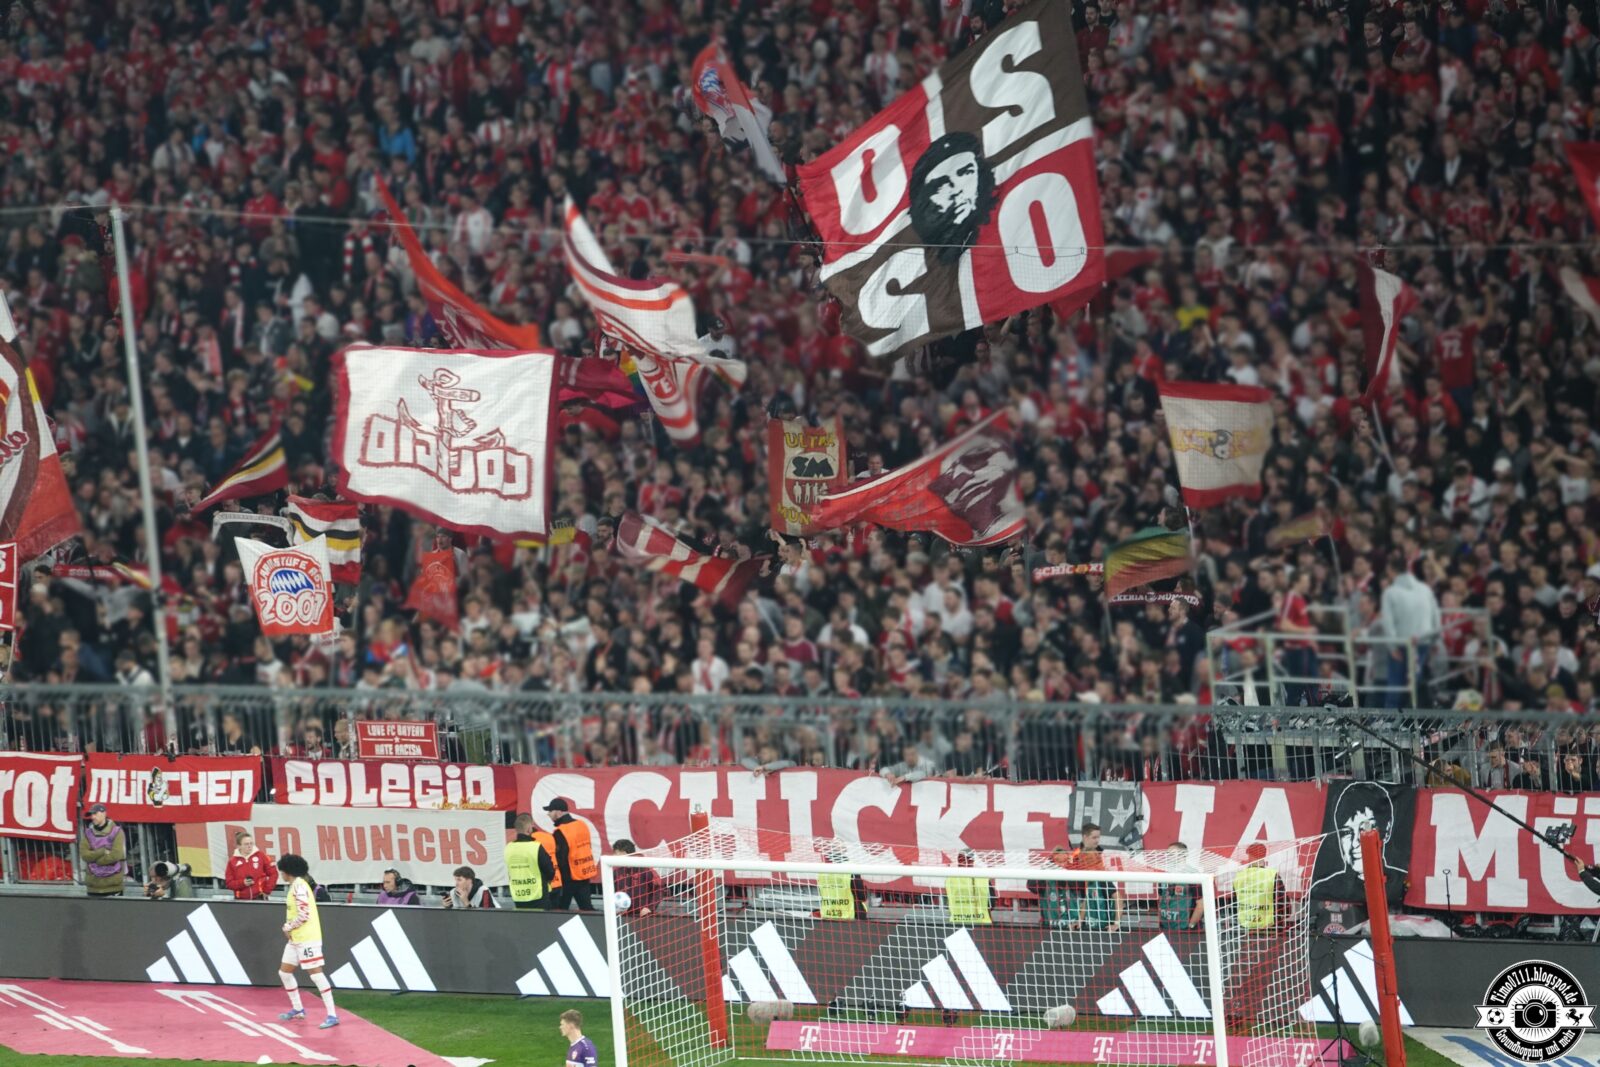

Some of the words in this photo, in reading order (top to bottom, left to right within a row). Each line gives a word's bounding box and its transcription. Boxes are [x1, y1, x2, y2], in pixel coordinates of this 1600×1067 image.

[367, 725, 386, 737] LOVE
[387, 725, 396, 737] FC
[397, 725, 425, 737] BAYERN
[375, 744, 394, 756] HATE
[395, 744, 423, 756] RACISM
[512, 877, 537, 886] TEWARD
[303, 946, 314, 958] 45
